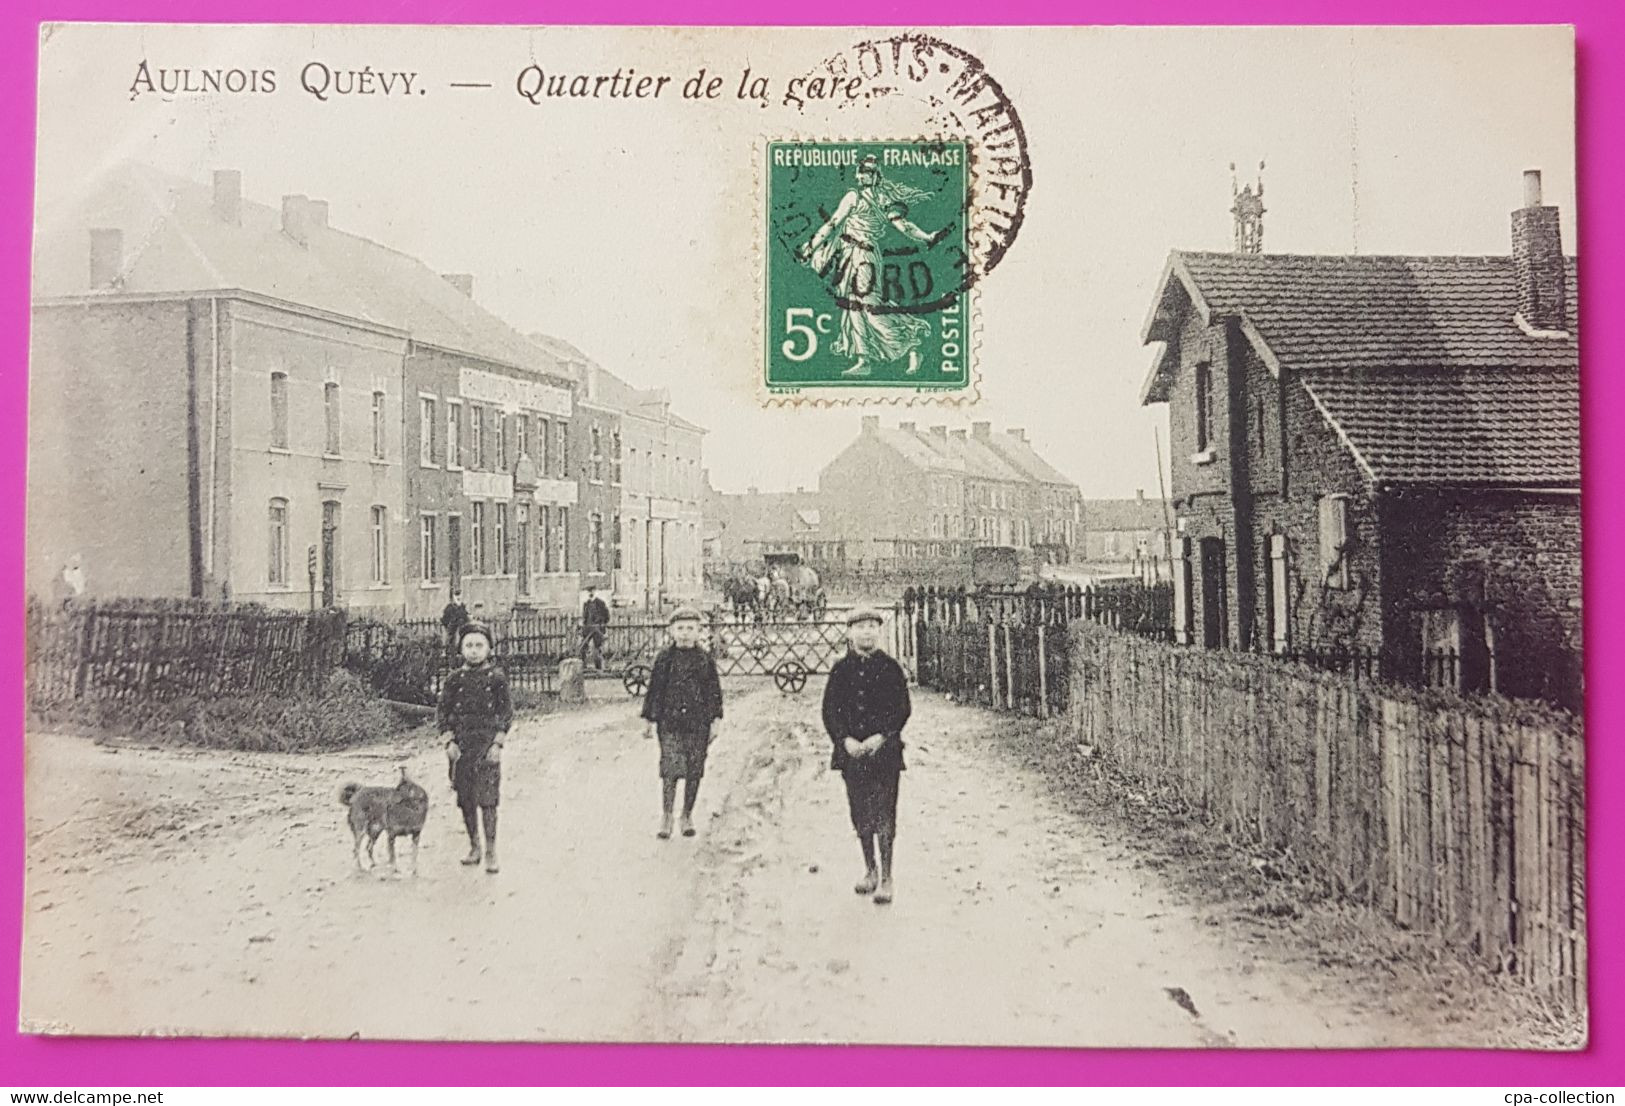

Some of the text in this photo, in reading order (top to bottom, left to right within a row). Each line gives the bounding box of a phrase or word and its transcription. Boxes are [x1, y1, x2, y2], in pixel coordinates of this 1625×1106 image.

[516, 64, 671, 105] Quartier
[682, 68, 723, 100] de
[736, 66, 770, 108] la
[783, 76, 871, 107] gare.
[774, 147, 961, 169] REPUBLIQUE FRANÇAISE
[817, 255, 934, 300] NORD
[941, 292, 961, 373] POSTE
